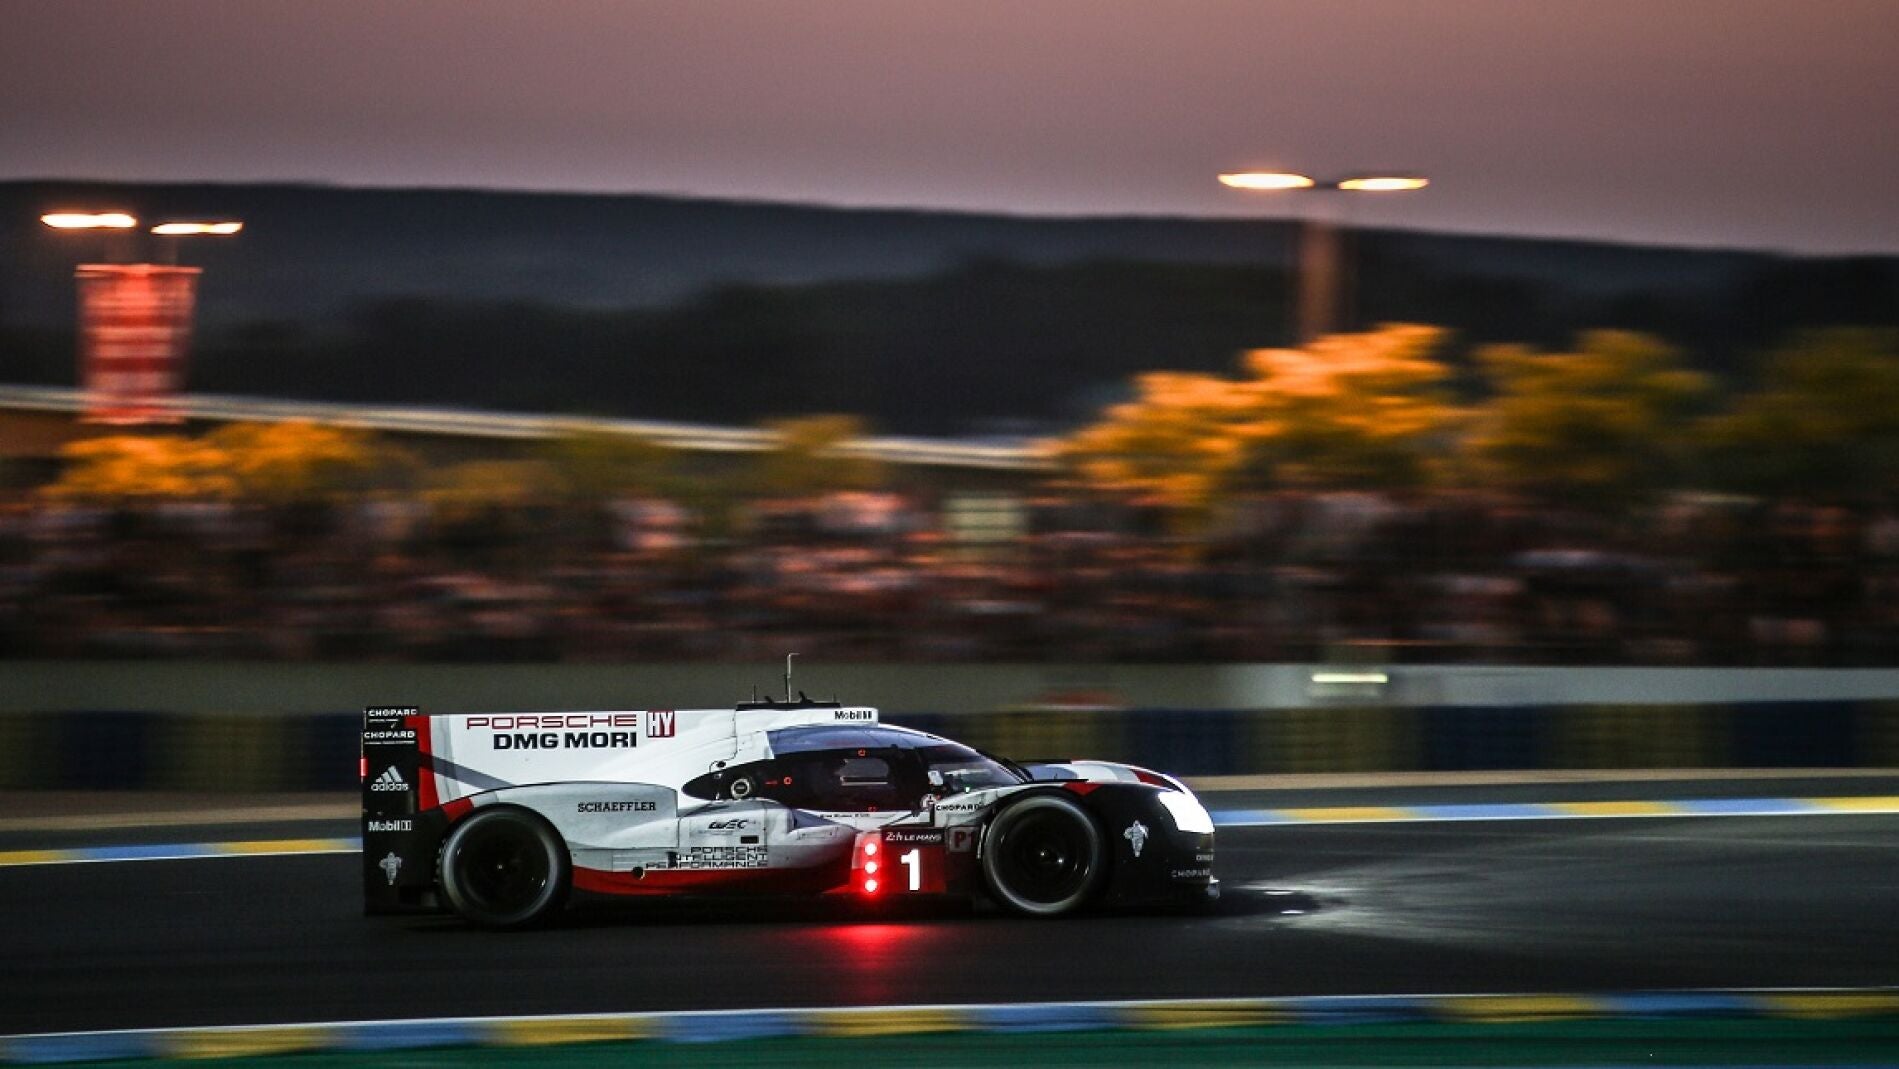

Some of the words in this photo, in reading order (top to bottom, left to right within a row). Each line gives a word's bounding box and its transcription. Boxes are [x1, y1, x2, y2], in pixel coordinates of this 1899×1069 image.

[835, 710, 862, 720] Mobil
[466, 714, 637, 730] PORSCHE
[647, 712, 674, 737] HY
[364, 730, 415, 739] CHOPARD
[493, 733, 559, 750] DMG
[564, 731, 637, 749] MORI
[370, 782, 409, 792] adidas
[577, 801, 657, 813] SCHAEFFLER
[935, 803, 980, 811] CHOPARD
[368, 820, 400, 832] Mobil
[708, 818, 749, 830] WEC
[916, 833, 942, 842] MANS
[691, 846, 768, 854] PORSCHE
[900, 848, 921, 891] 1
